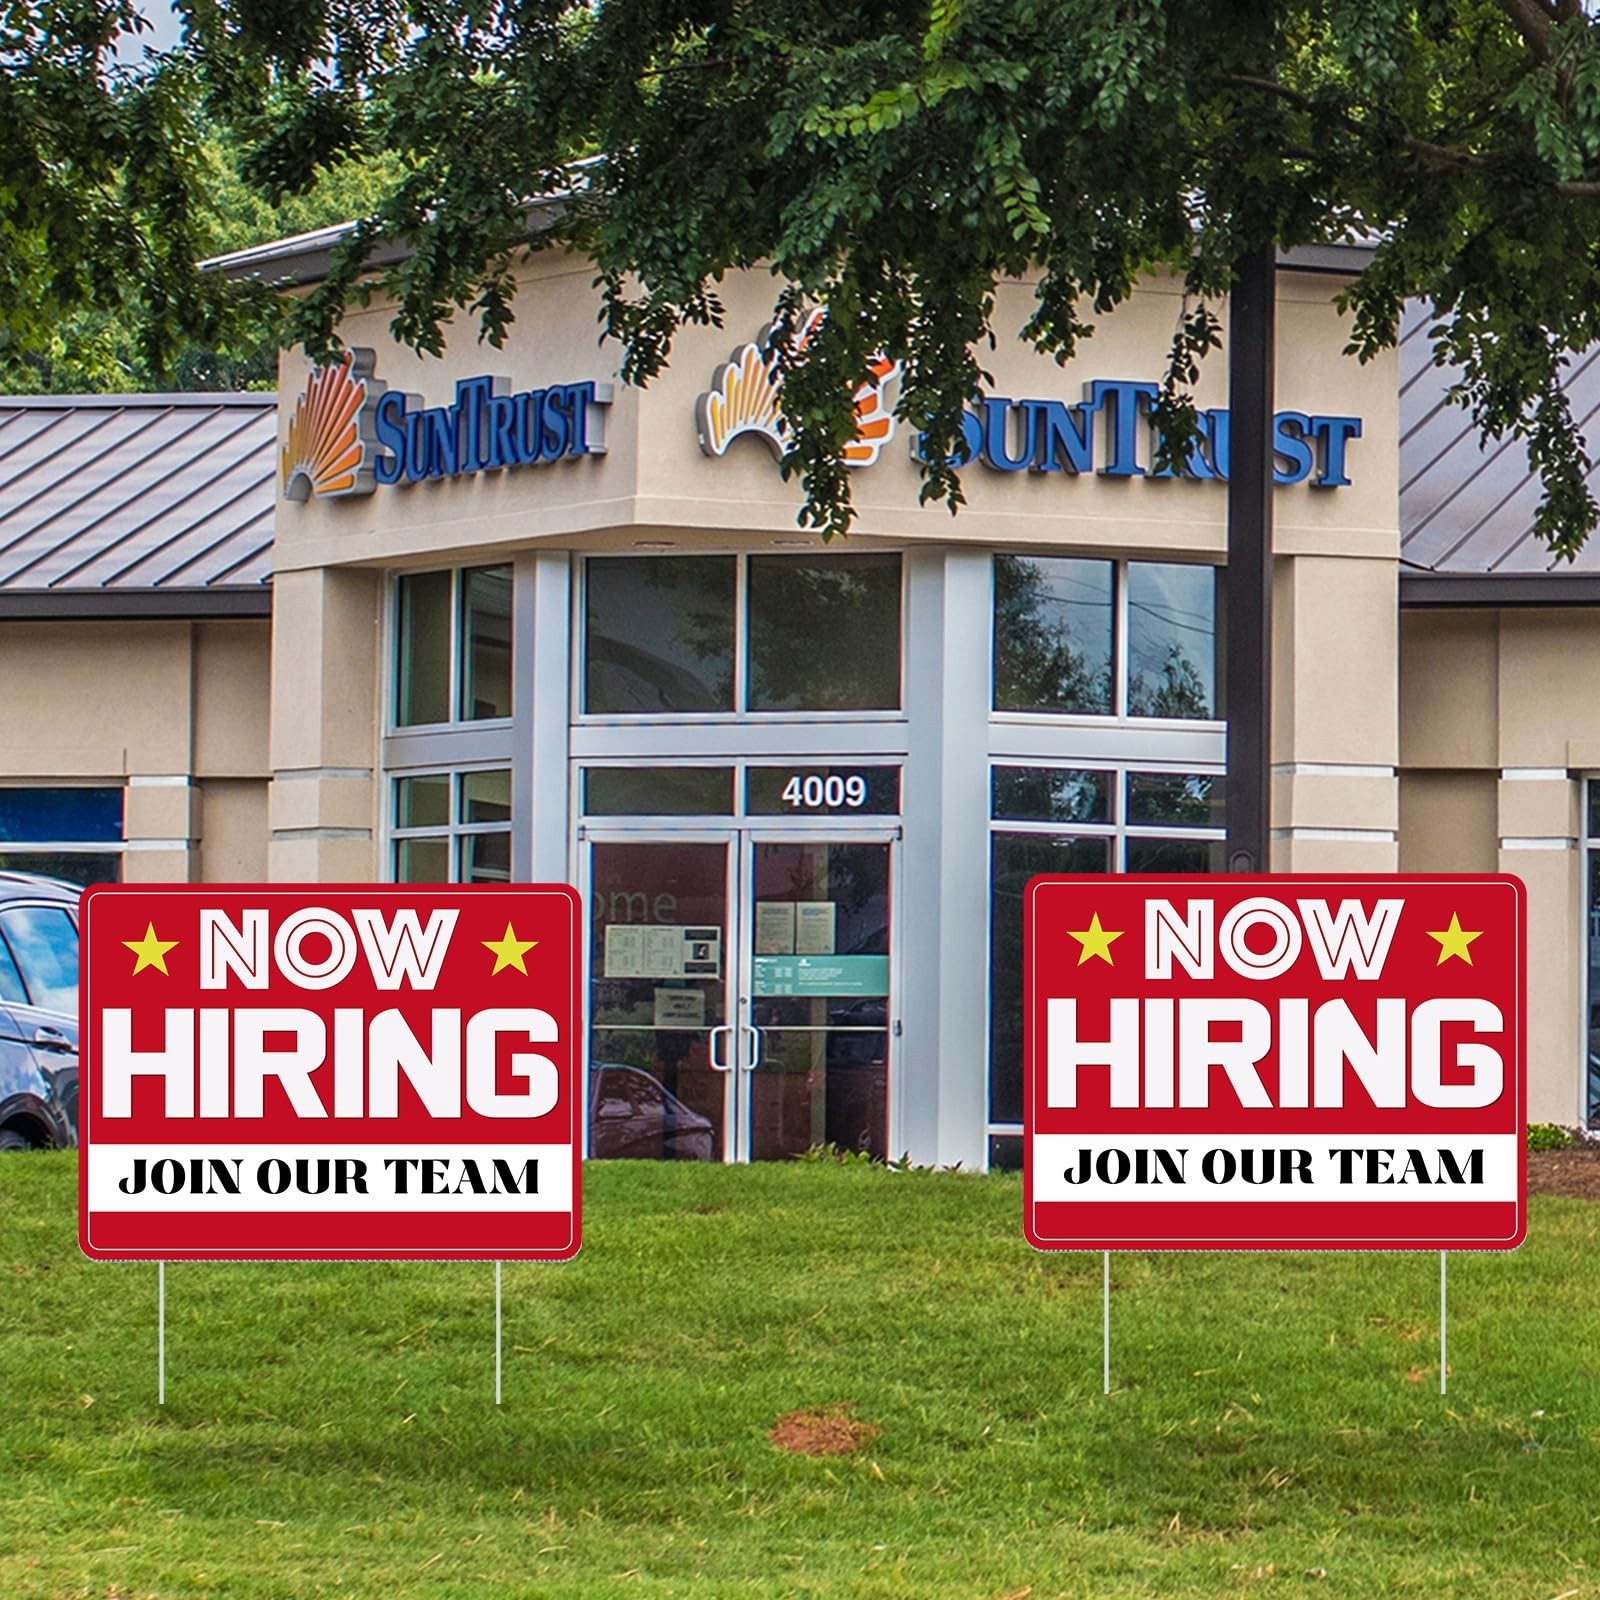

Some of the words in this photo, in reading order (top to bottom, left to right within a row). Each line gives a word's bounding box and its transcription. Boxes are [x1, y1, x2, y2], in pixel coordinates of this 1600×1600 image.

[374, 374, 596, 485] SUNTRUST
[782, 775, 867, 808] 4009
[200, 906, 460, 991] NOW
[1145, 896, 1405, 981] NOW
[102, 1008, 560, 1119] HIRING
[1047, 998, 1505, 1109] HIRING
[118, 1158, 244, 1196] JOIN
[256, 1158, 369, 1196] OUR
[383, 1158, 540, 1196] TEAM
[1063, 1148, 1189, 1186] JOIN
[1201, 1148, 1314, 1186] OUR
[1328, 1148, 1485, 1186] TEAM
